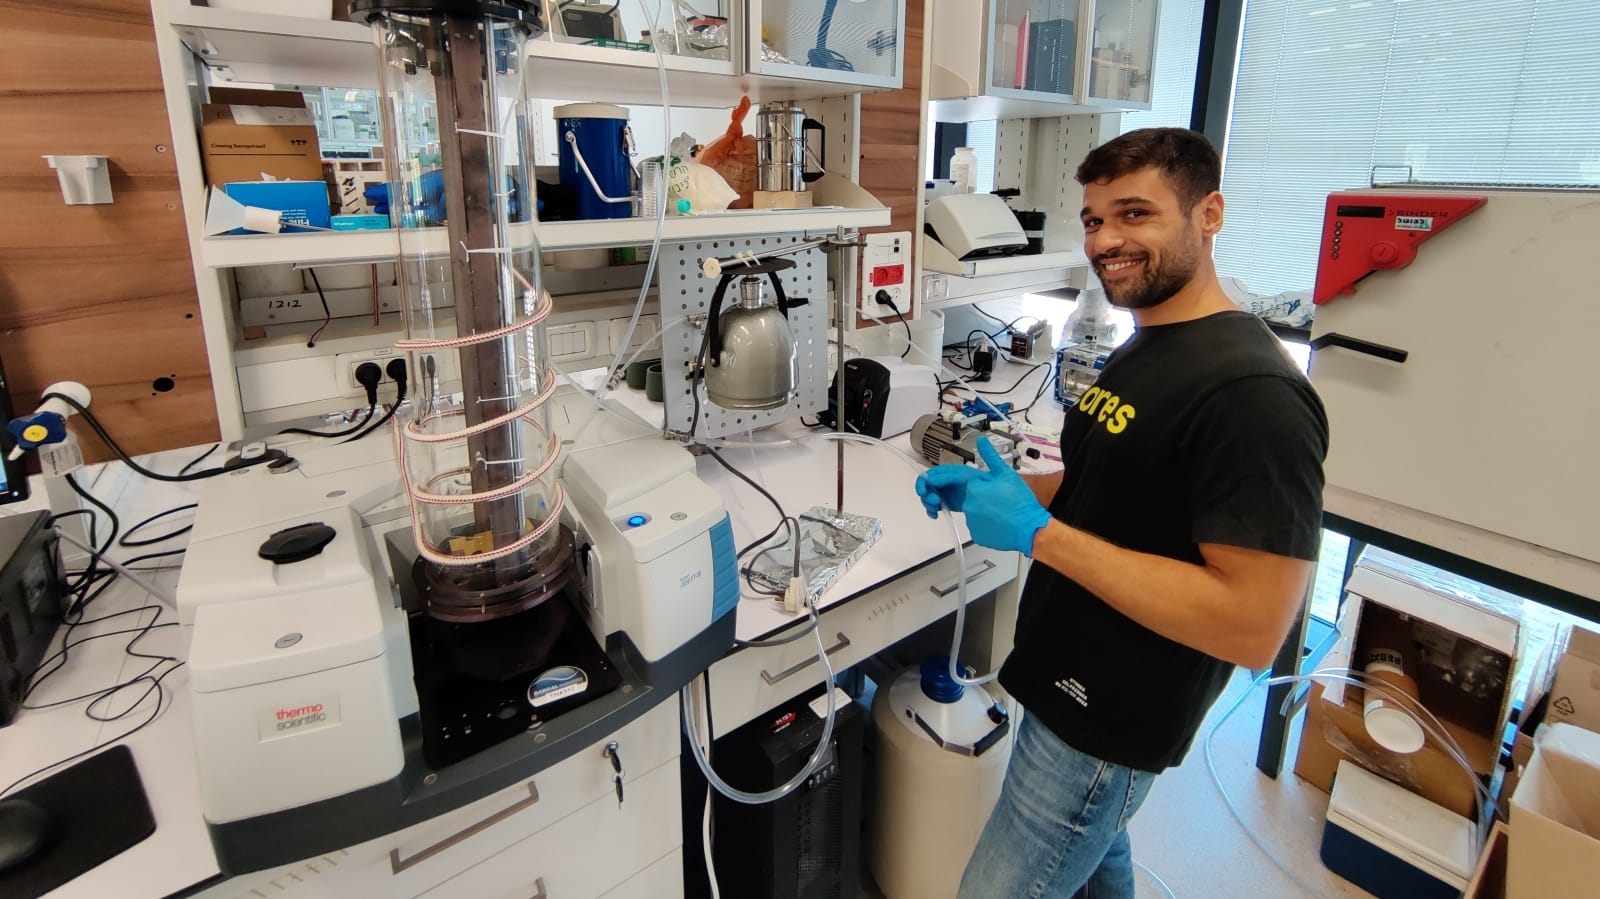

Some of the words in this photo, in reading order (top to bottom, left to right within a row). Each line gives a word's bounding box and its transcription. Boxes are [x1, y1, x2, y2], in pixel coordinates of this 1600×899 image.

[1079, 386, 1136, 434] ores
[276, 703, 324, 721] thermo
[276, 712, 328, 732] scientific
